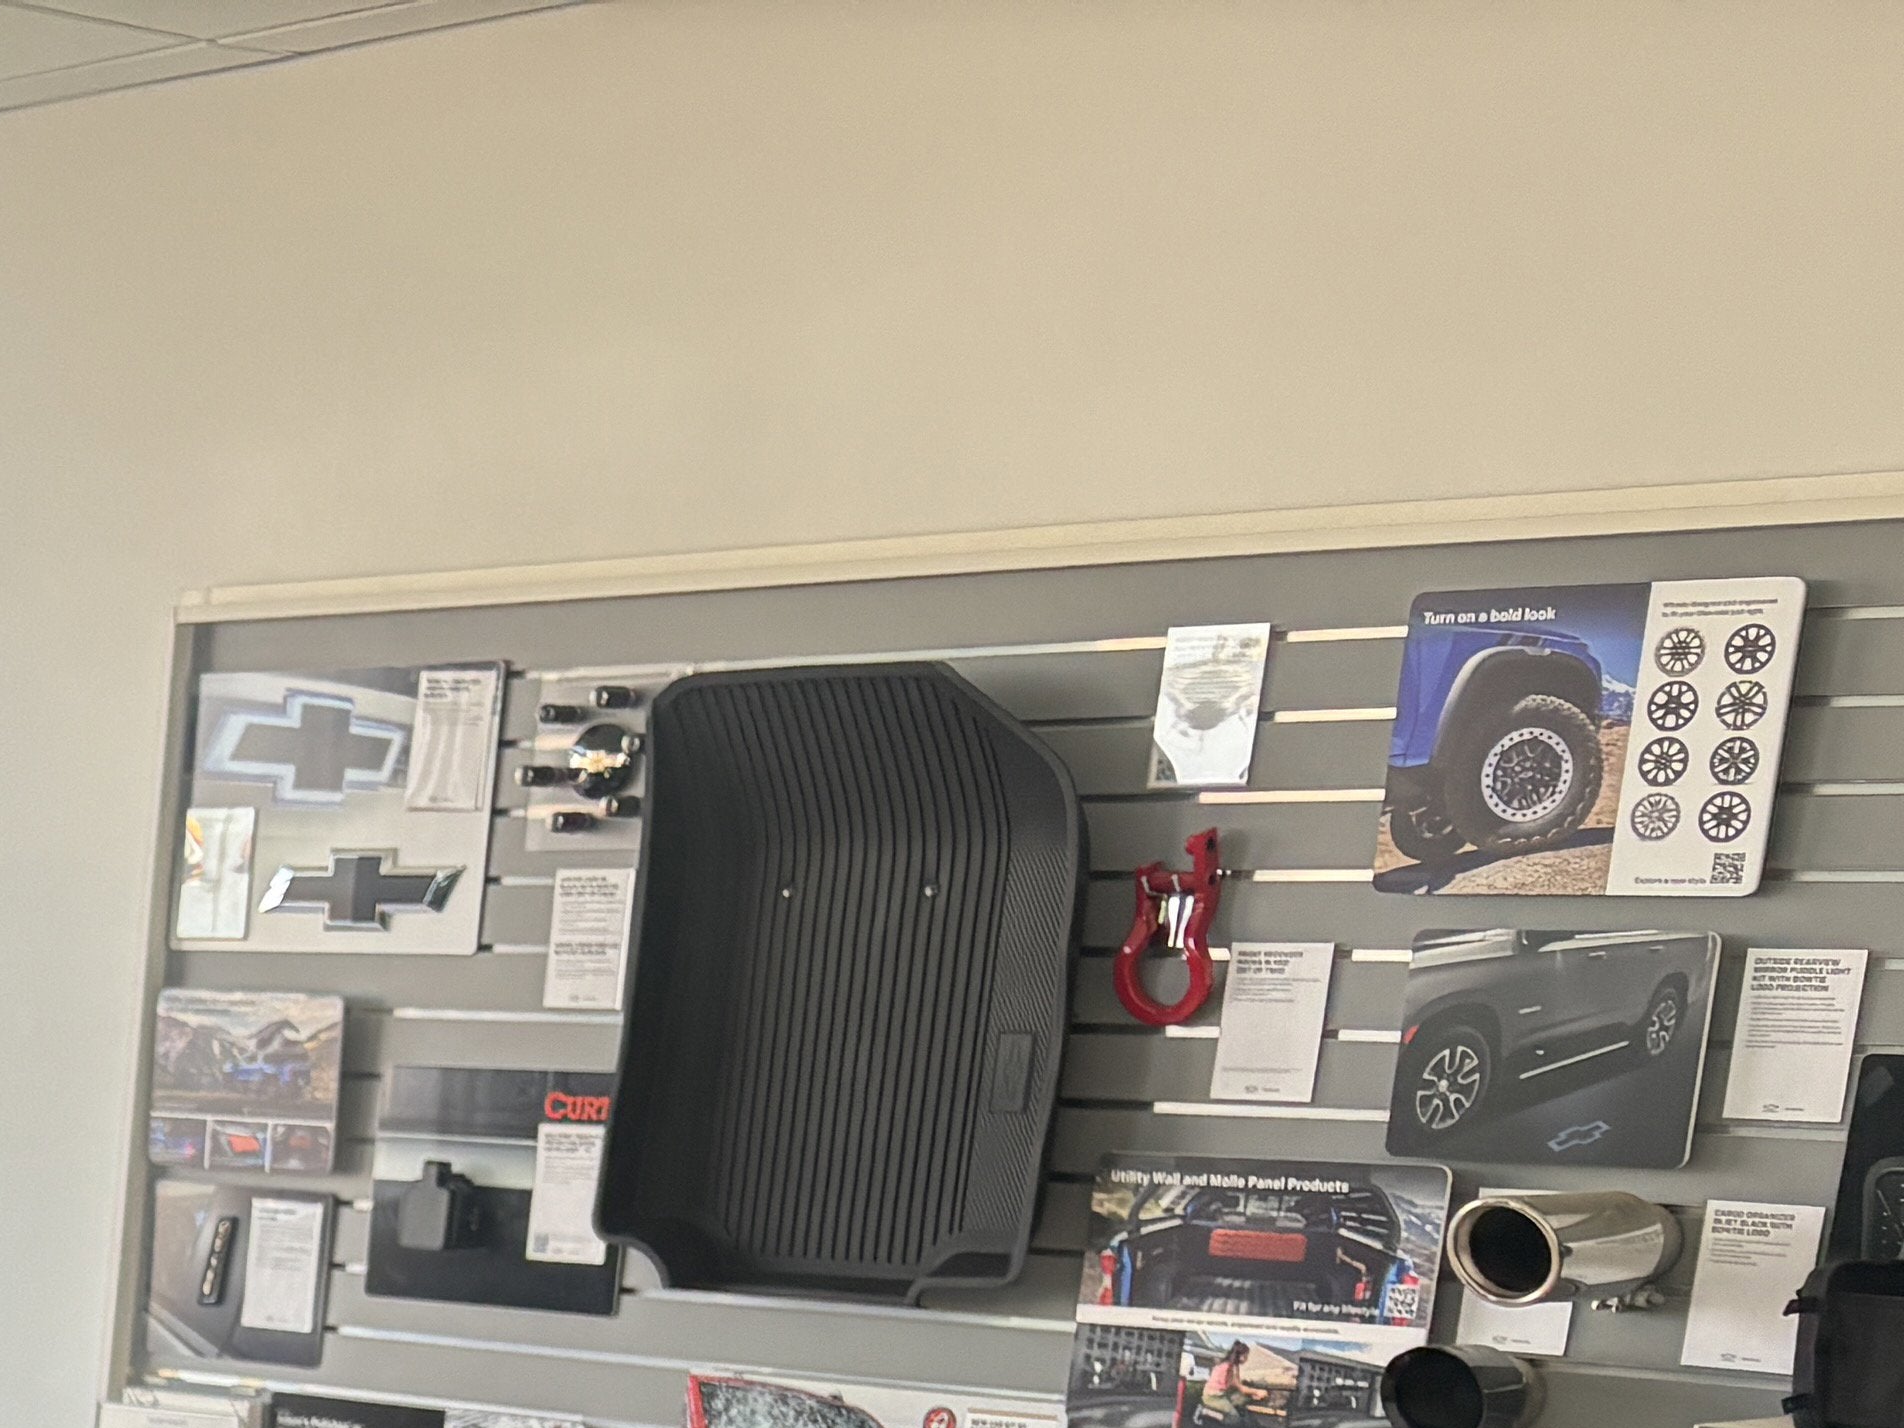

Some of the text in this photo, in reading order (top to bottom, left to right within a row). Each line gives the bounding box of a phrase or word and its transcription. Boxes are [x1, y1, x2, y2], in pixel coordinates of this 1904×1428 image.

[1423, 606, 1557, 625] Turn on a bold look
[1110, 1168, 1350, 1193] Utility Wall and Molle Panel Products
